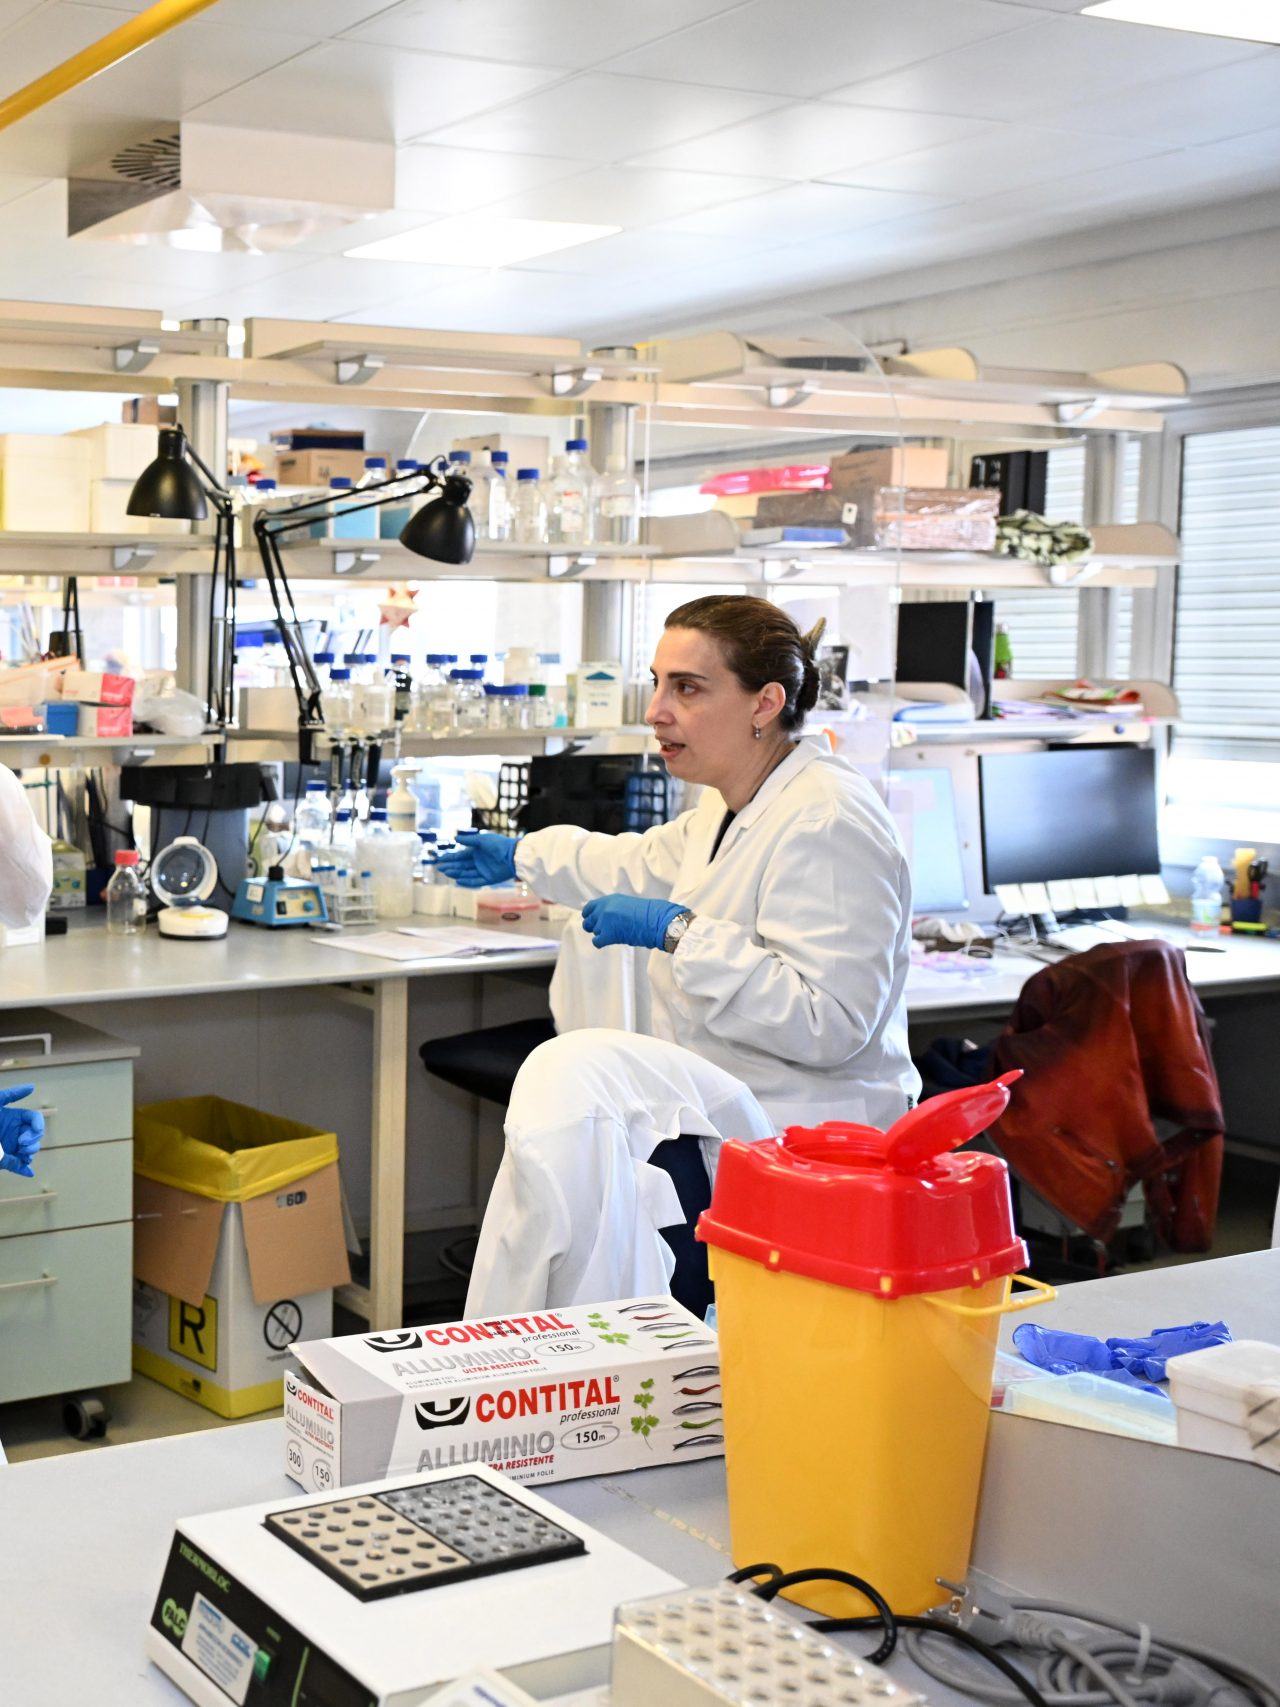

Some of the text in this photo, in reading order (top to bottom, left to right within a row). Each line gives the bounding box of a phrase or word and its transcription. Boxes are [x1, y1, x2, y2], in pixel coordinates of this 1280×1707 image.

[179, 1301, 206, 1354] R
[425, 1313, 575, 1346] CONTITAL
[521, 1328, 581, 1343] professional
[392, 1346, 531, 1376] ALLUMINIO
[462, 1359, 540, 1374] ULTRA RESISTENTE
[297, 1389, 334, 1420] CONTITAL
[475, 1376, 620, 1423] CONTITAL
[286, 1404, 335, 1445] ALLUMINIO
[559, 1404, 620, 1426] professional
[289, 1449, 301, 1468] 300
[416, 1431, 555, 1473] ALLUMINIO
[505, 1454, 554, 1470] RESISTENTE
[315, 1465, 330, 1483] 150
[536, 1469, 554, 1477] FOLIE
